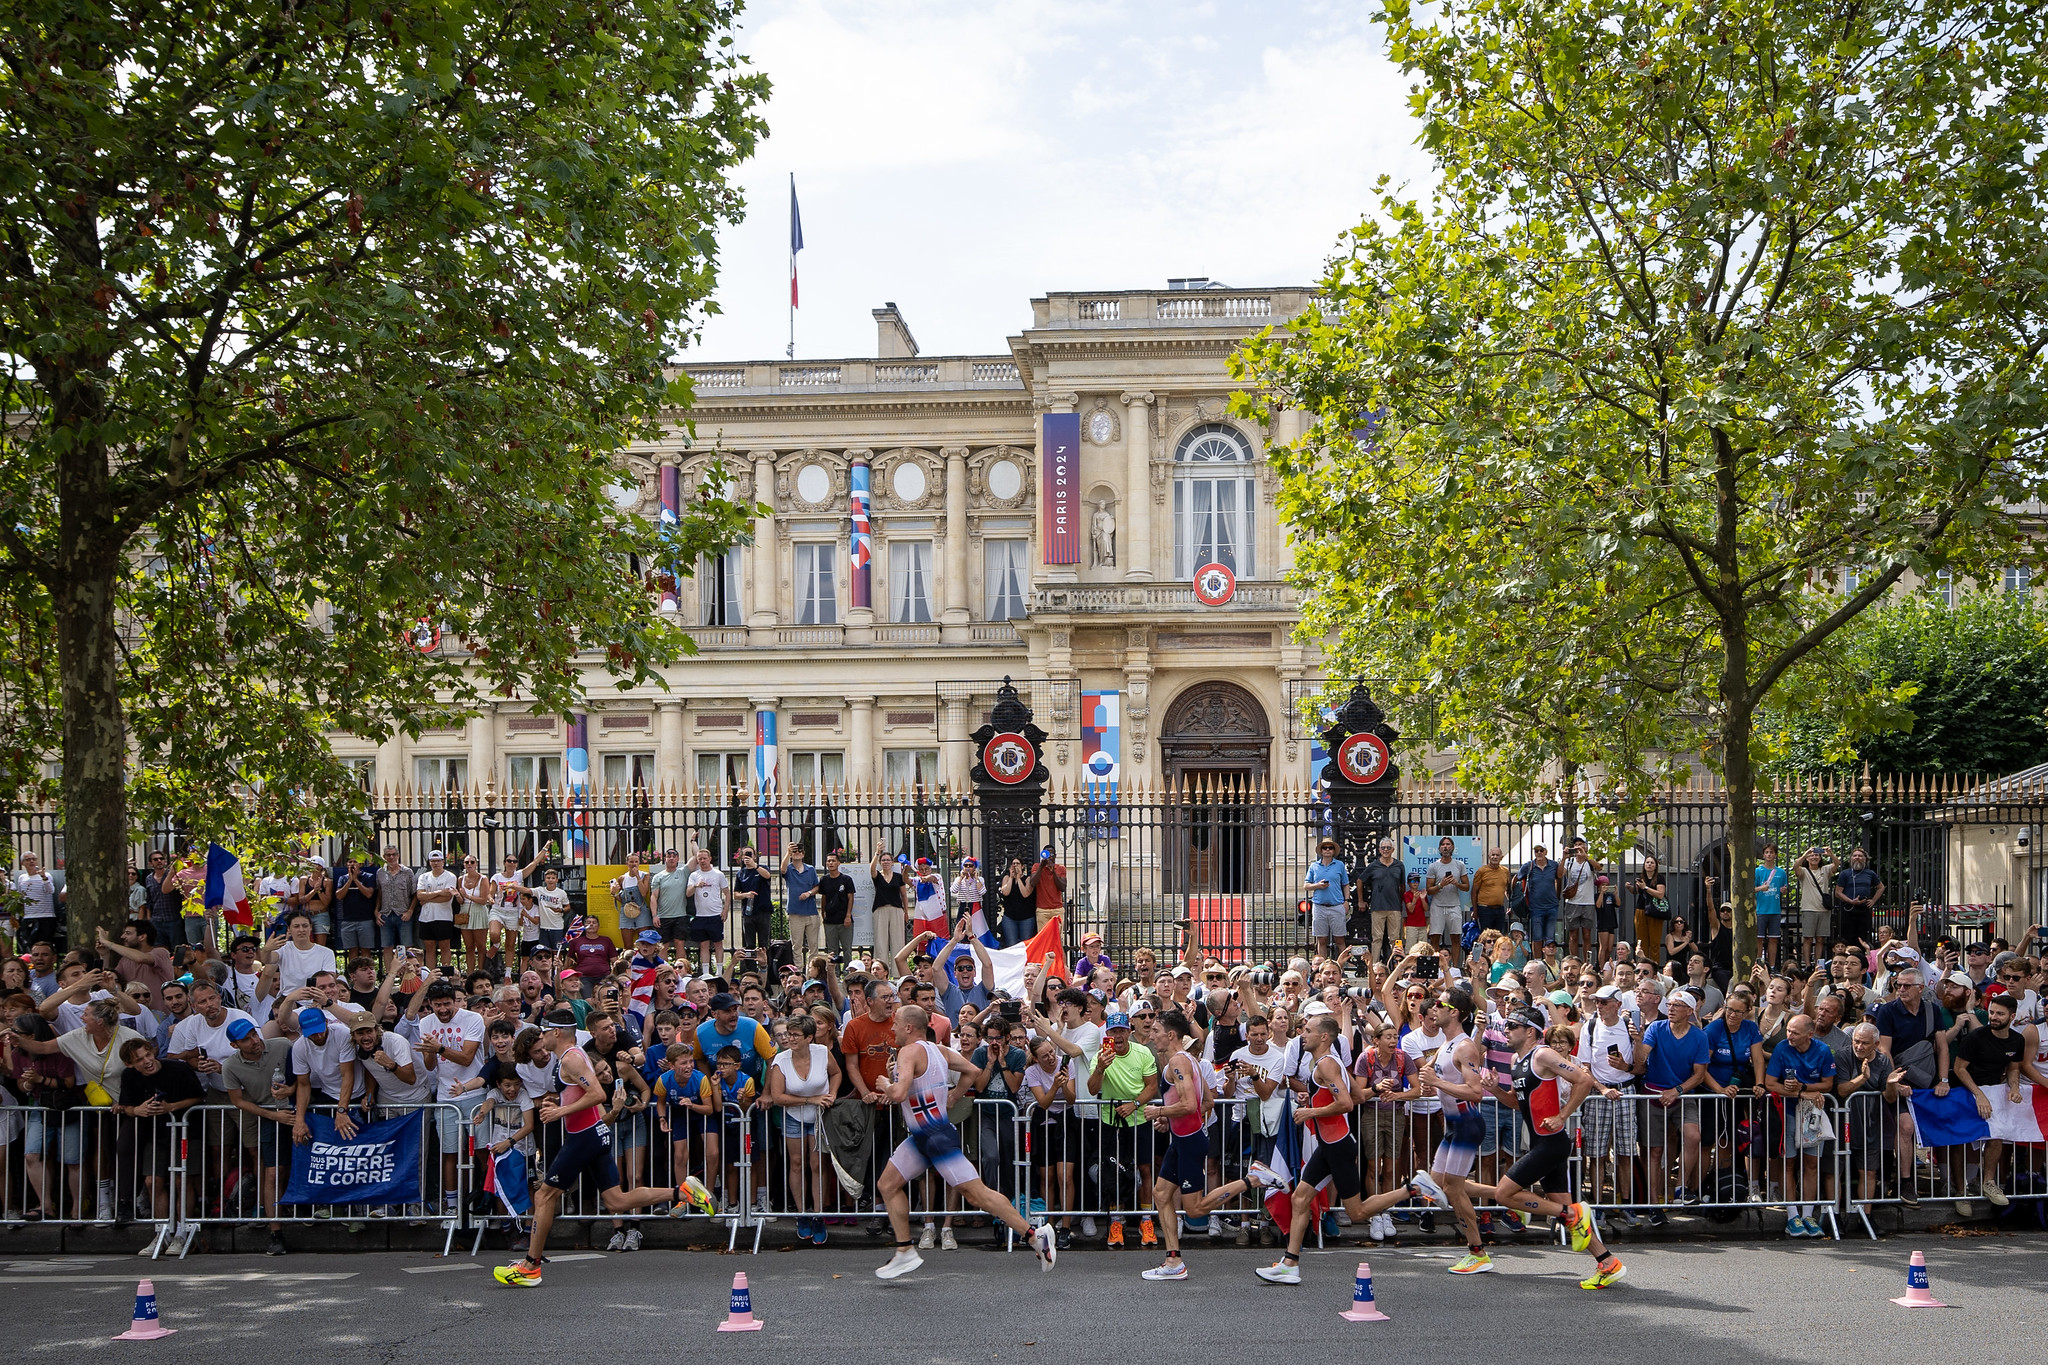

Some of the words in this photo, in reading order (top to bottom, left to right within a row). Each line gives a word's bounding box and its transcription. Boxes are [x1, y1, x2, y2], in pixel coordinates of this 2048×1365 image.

[1056, 446, 1067, 486] 2024
[1056, 490, 1067, 534] PARIS
[540, 894, 560, 904] FRANCE
[1174, 1068, 1184, 1081] 29
[311, 1140, 396, 1157] GIANT
[325, 1153, 395, 1172] PIERRE
[307, 1170, 326, 1185] LE
[329, 1168, 394, 1186] CORRE
